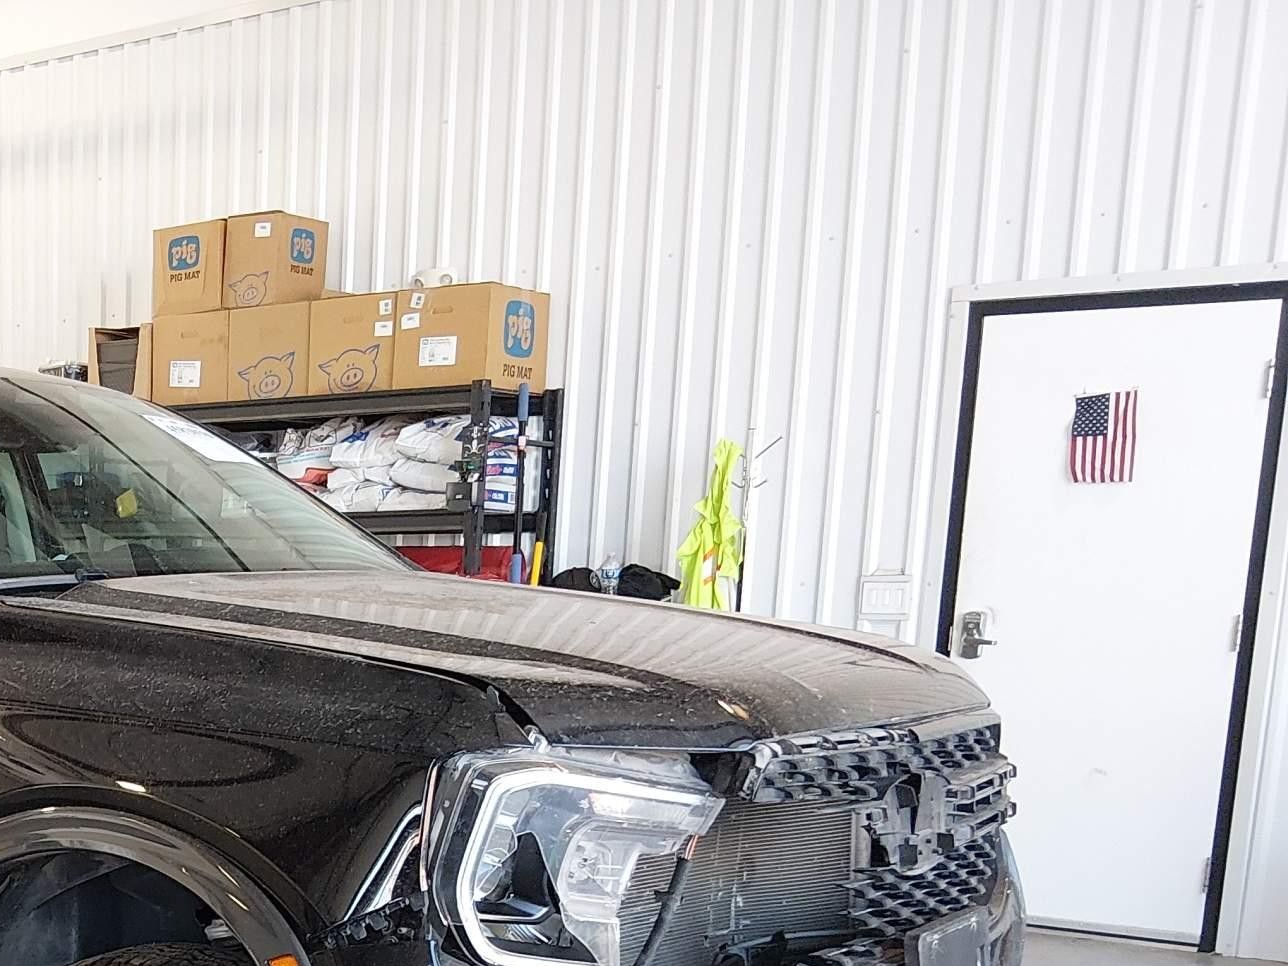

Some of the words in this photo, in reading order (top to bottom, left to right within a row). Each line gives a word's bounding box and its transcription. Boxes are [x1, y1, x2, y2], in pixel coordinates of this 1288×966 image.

[290, 263, 301, 274] PIG
[301, 266, 314, 276] MAT
[170, 272, 183, 283] PIG
[184, 270, 201, 282] MAT
[502, 363, 515, 378] PIG
[516, 367, 533, 381] MAT
